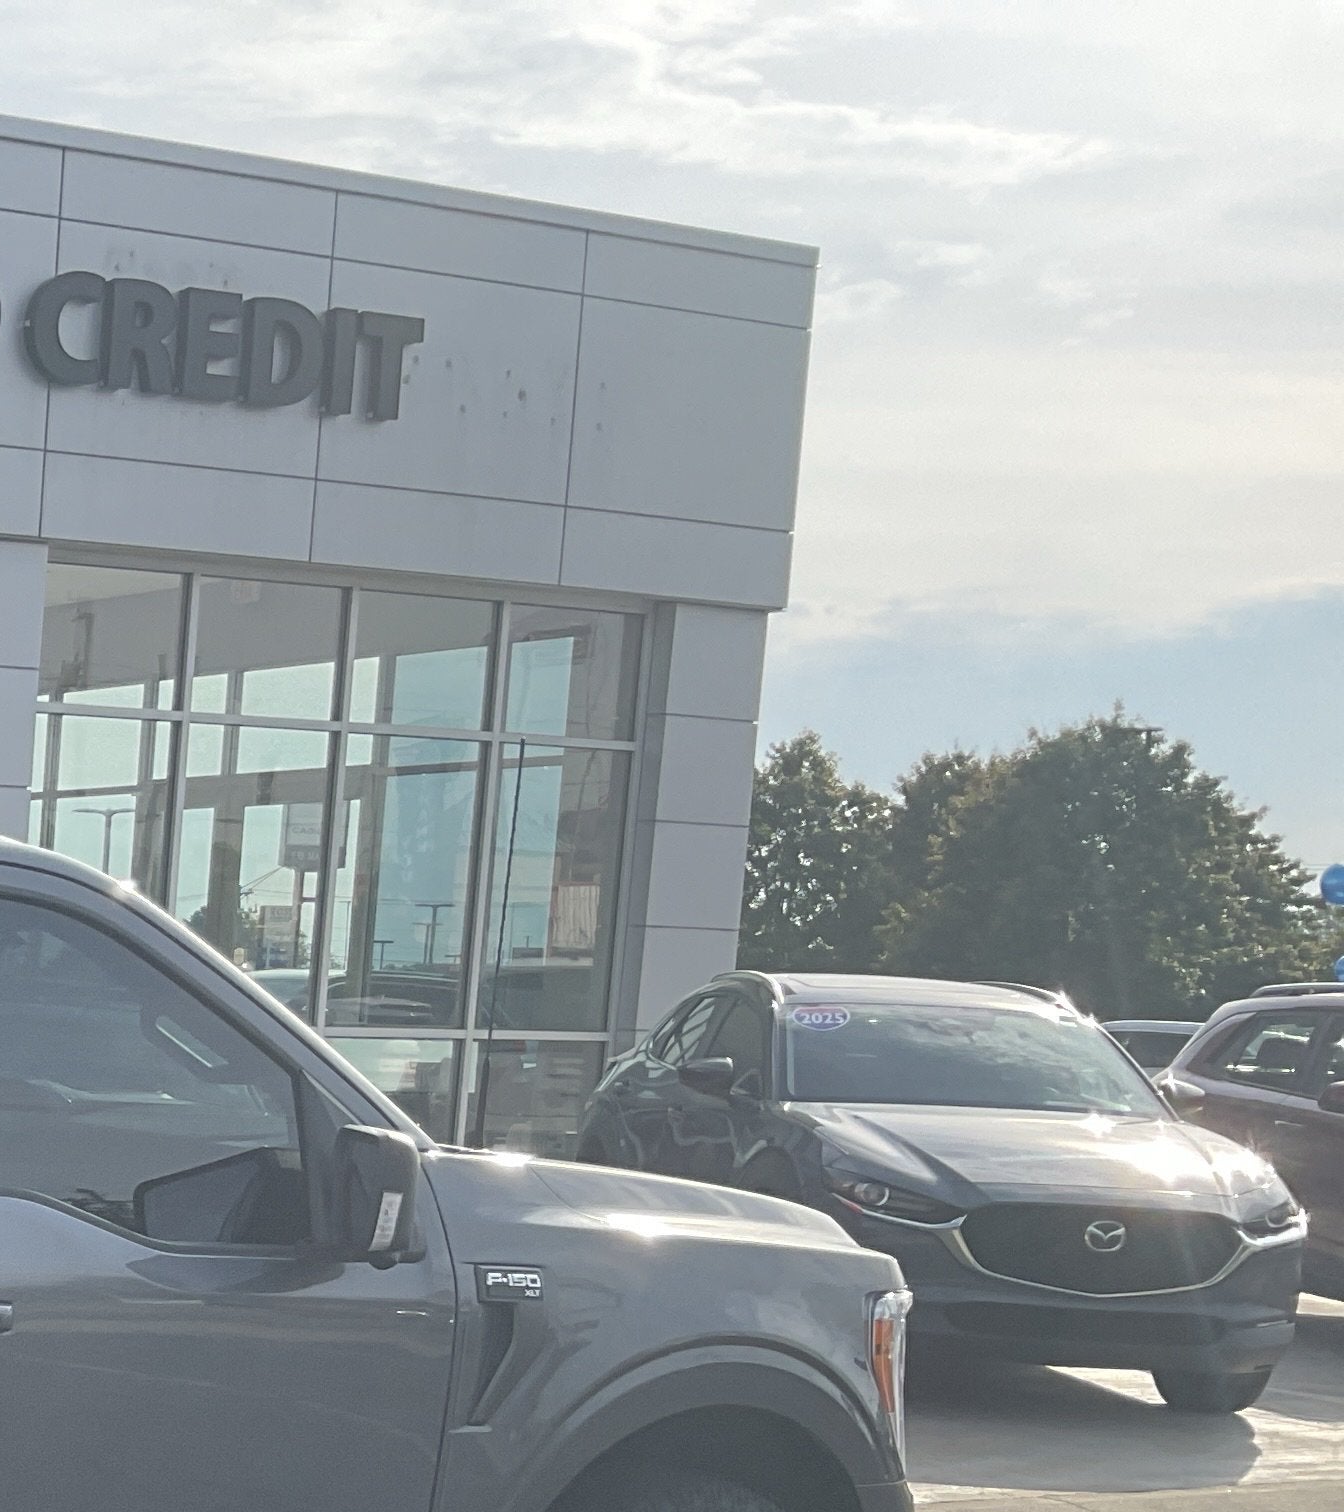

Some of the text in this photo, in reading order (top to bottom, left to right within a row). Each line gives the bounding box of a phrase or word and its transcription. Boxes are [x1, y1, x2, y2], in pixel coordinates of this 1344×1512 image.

[24, 271, 426, 422] CREDIT
[799, 1012, 845, 1024] 2025
[486, 1272, 542, 1287] F-150
[524, 1288, 541, 1297] XLT
